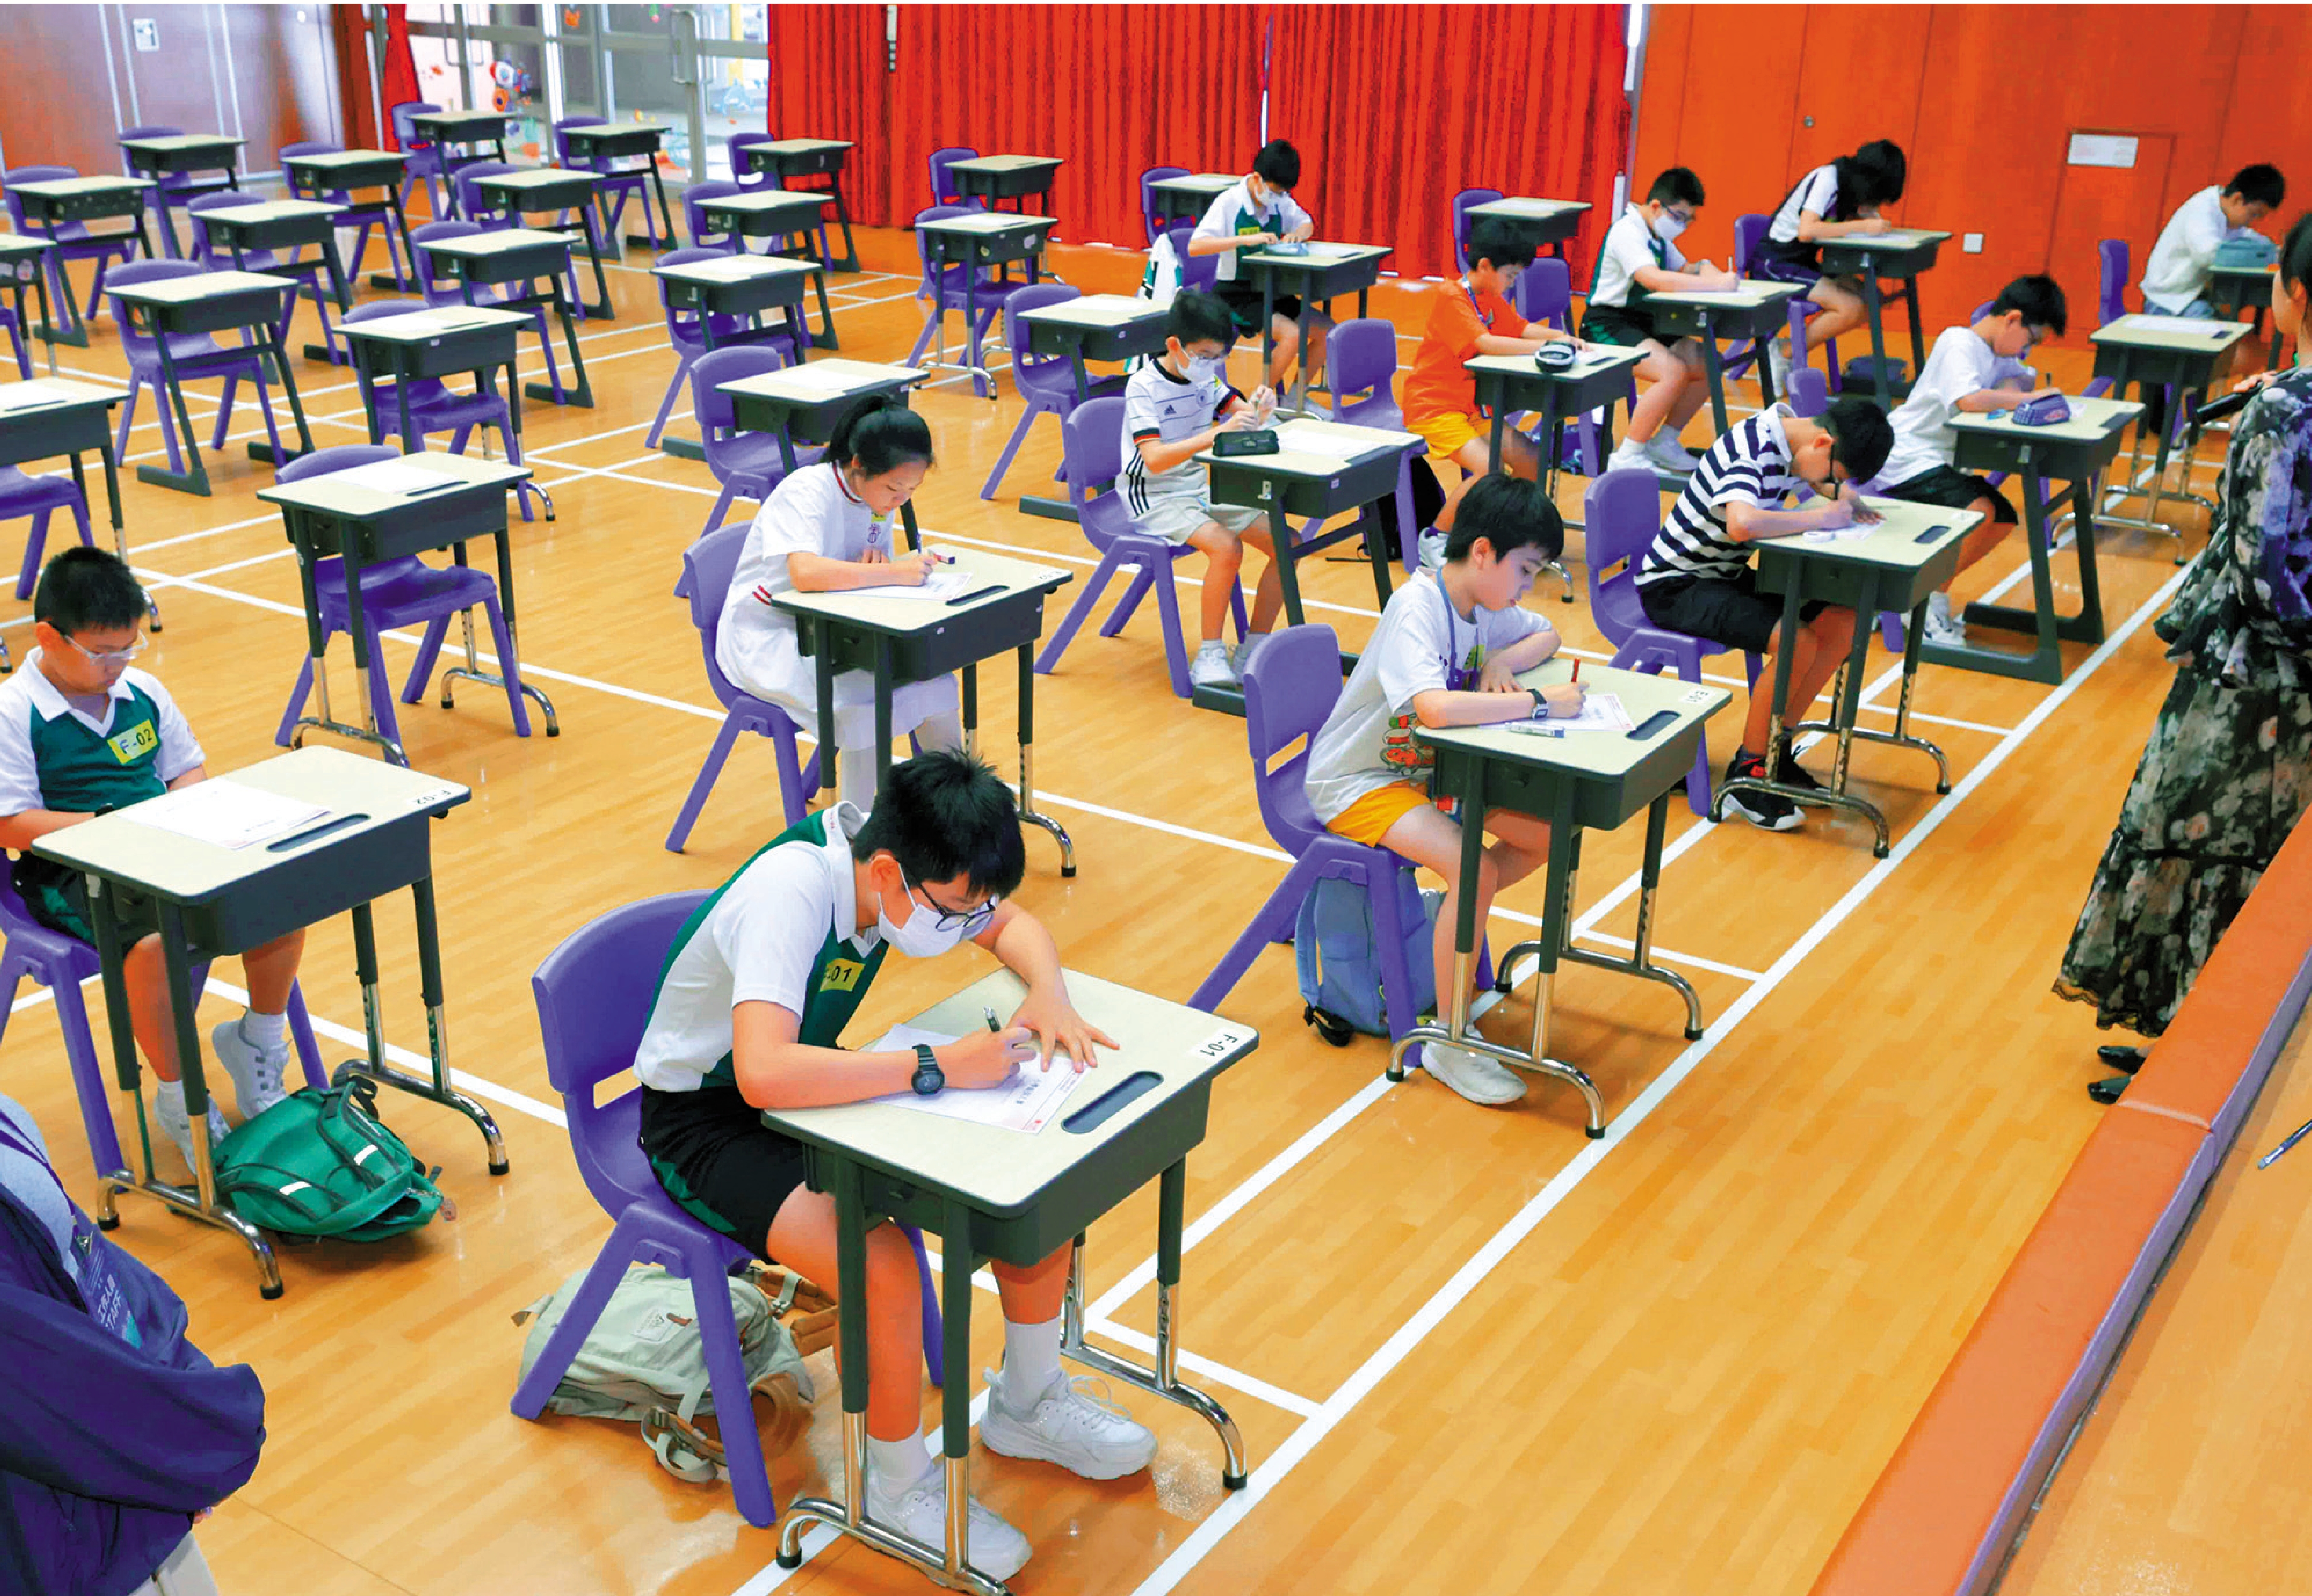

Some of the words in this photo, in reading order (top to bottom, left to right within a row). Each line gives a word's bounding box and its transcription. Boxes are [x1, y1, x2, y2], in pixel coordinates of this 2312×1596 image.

[119, 728, 153, 755] F-02
[825, 966, 852, 983] -01
[1199, 1033, 1239, 1057] F-01
